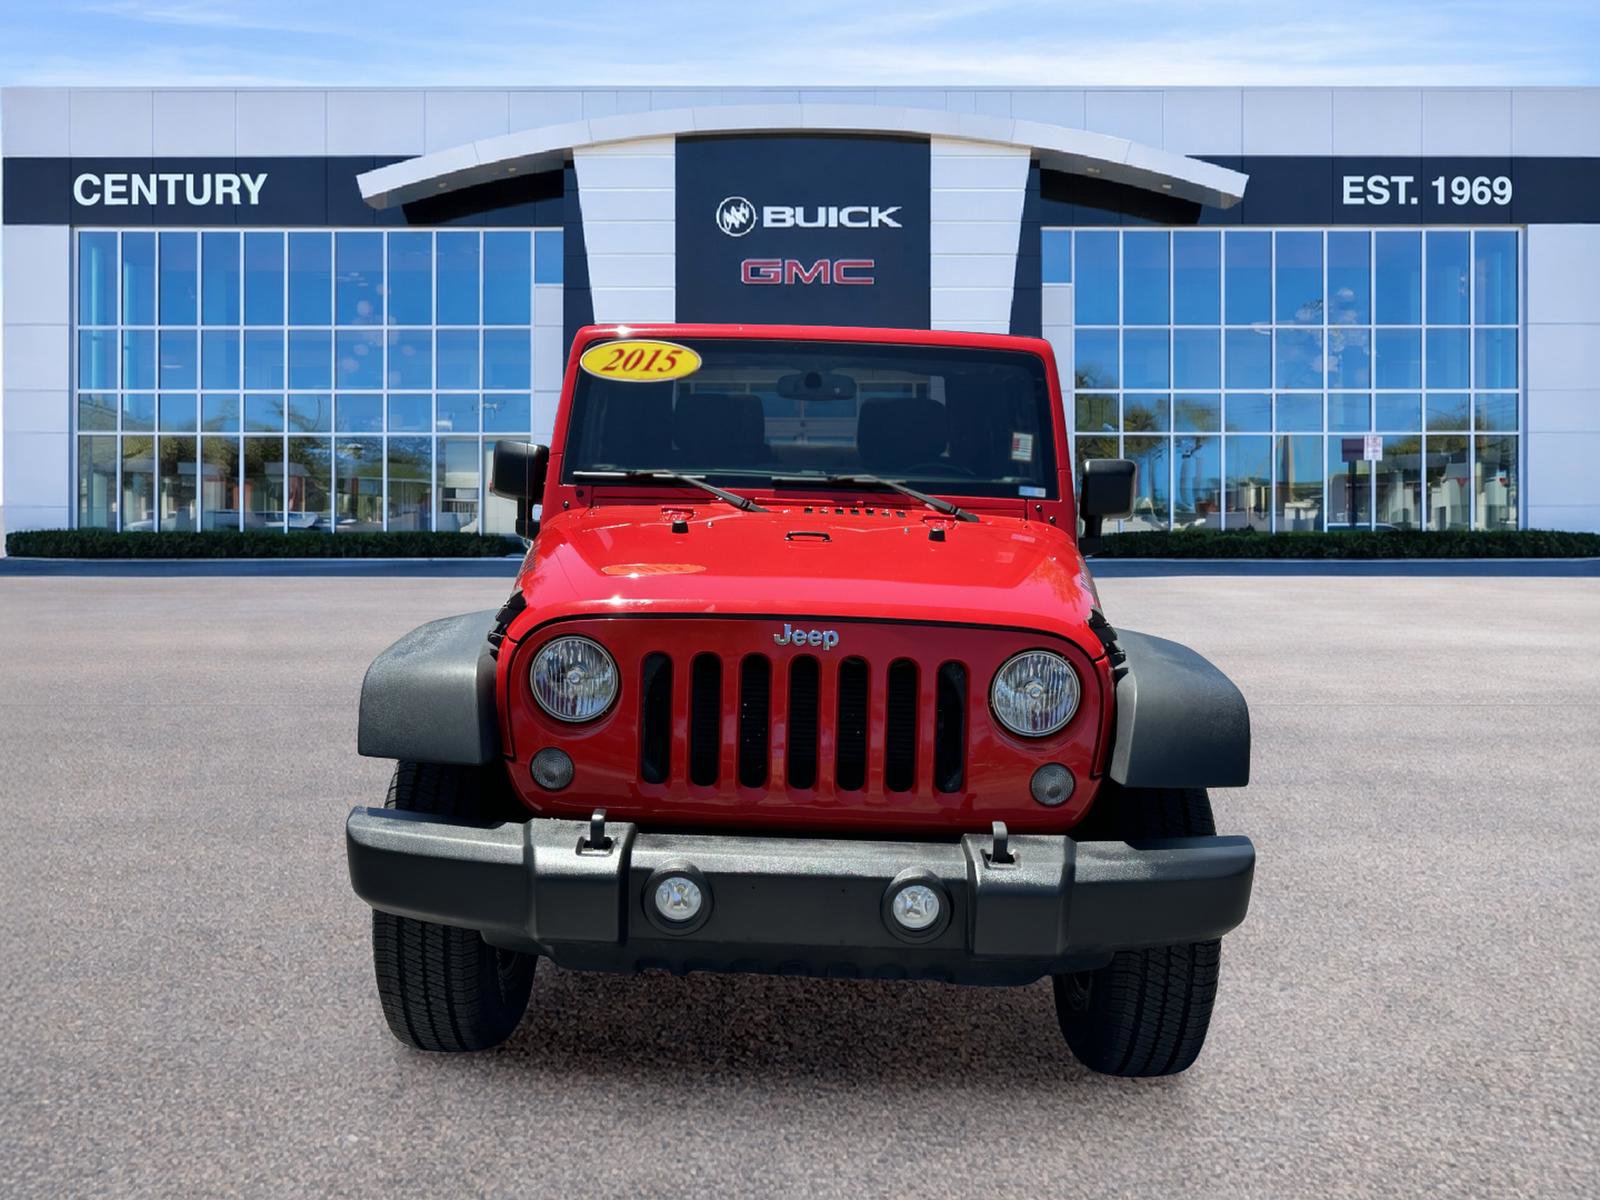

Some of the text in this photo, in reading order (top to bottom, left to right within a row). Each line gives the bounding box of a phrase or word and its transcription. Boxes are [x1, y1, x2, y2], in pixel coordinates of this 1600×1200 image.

[74, 173, 267, 206] CENTURY
[1343, 175, 1512, 206] EST. 1969
[763, 206, 902, 227] BUICK
[741, 258, 875, 285] GMC
[601, 348, 682, 373] 2015
[774, 623, 839, 650] Jeep
